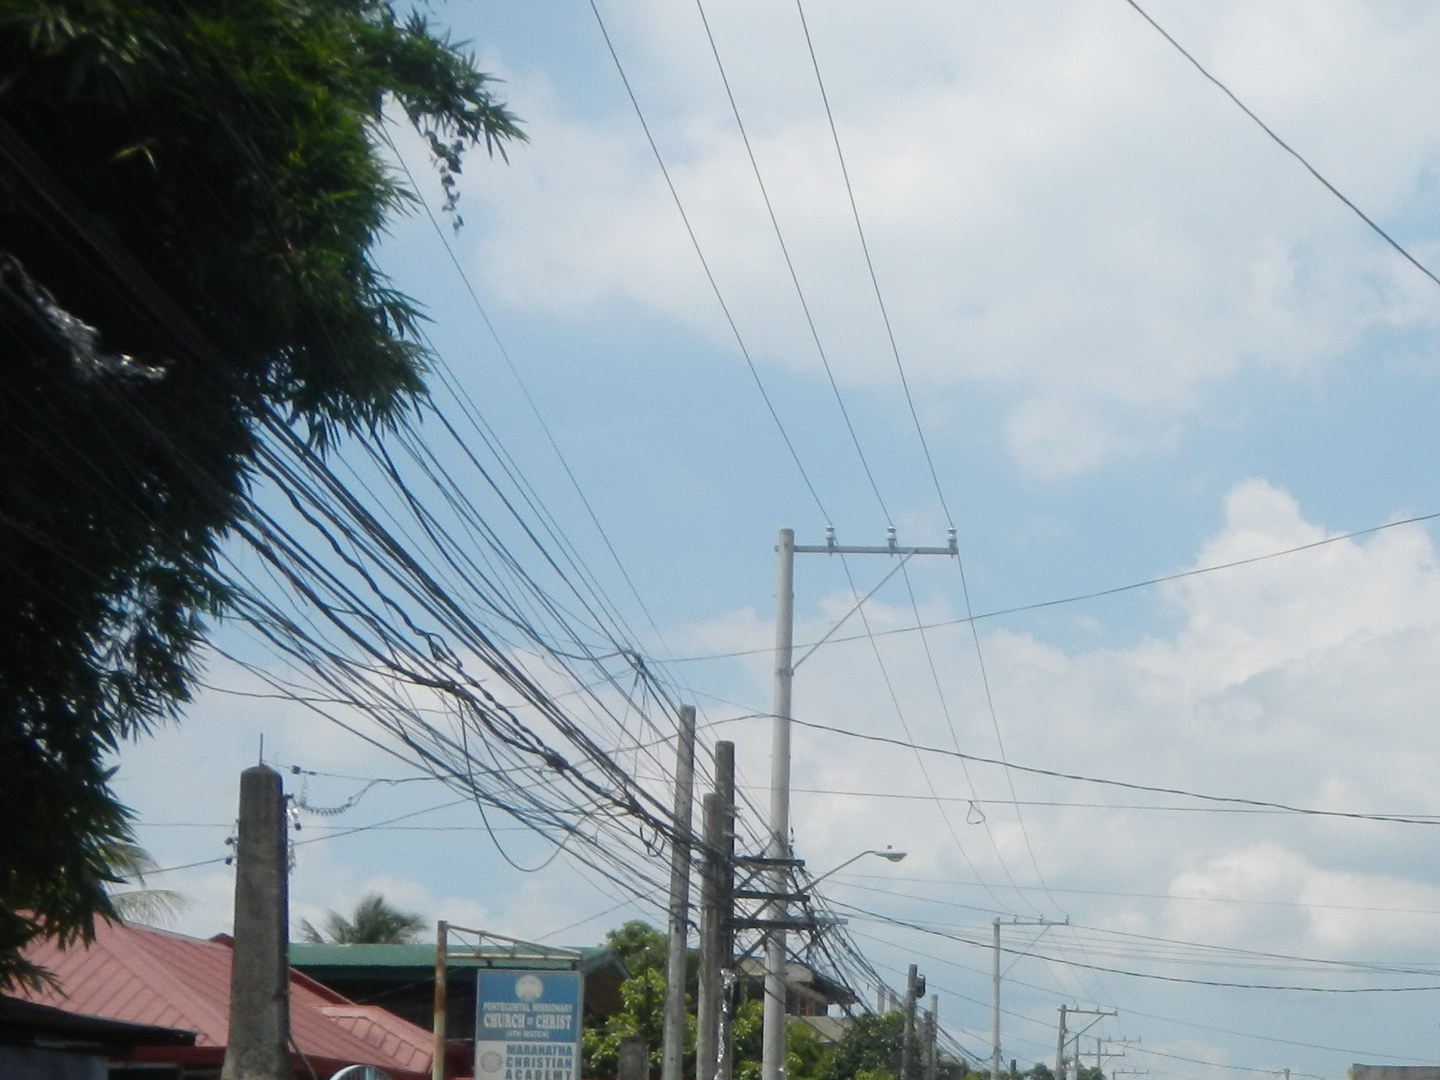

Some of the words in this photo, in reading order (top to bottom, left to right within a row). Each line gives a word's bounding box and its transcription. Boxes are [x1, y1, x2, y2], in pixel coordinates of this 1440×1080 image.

[483, 1002, 530, 1011] PENTECOSTAL
[532, 1003, 573, 1012] MISSIONARY
[484, 1012, 525, 1028] CHURCH
[535, 1014, 572, 1029] CHRIST
[506, 1044, 572, 1056] MARANATHA
[506, 1057, 572, 1068] CHRISTIAN
[505, 1069, 571, 1080] ACADEMY
